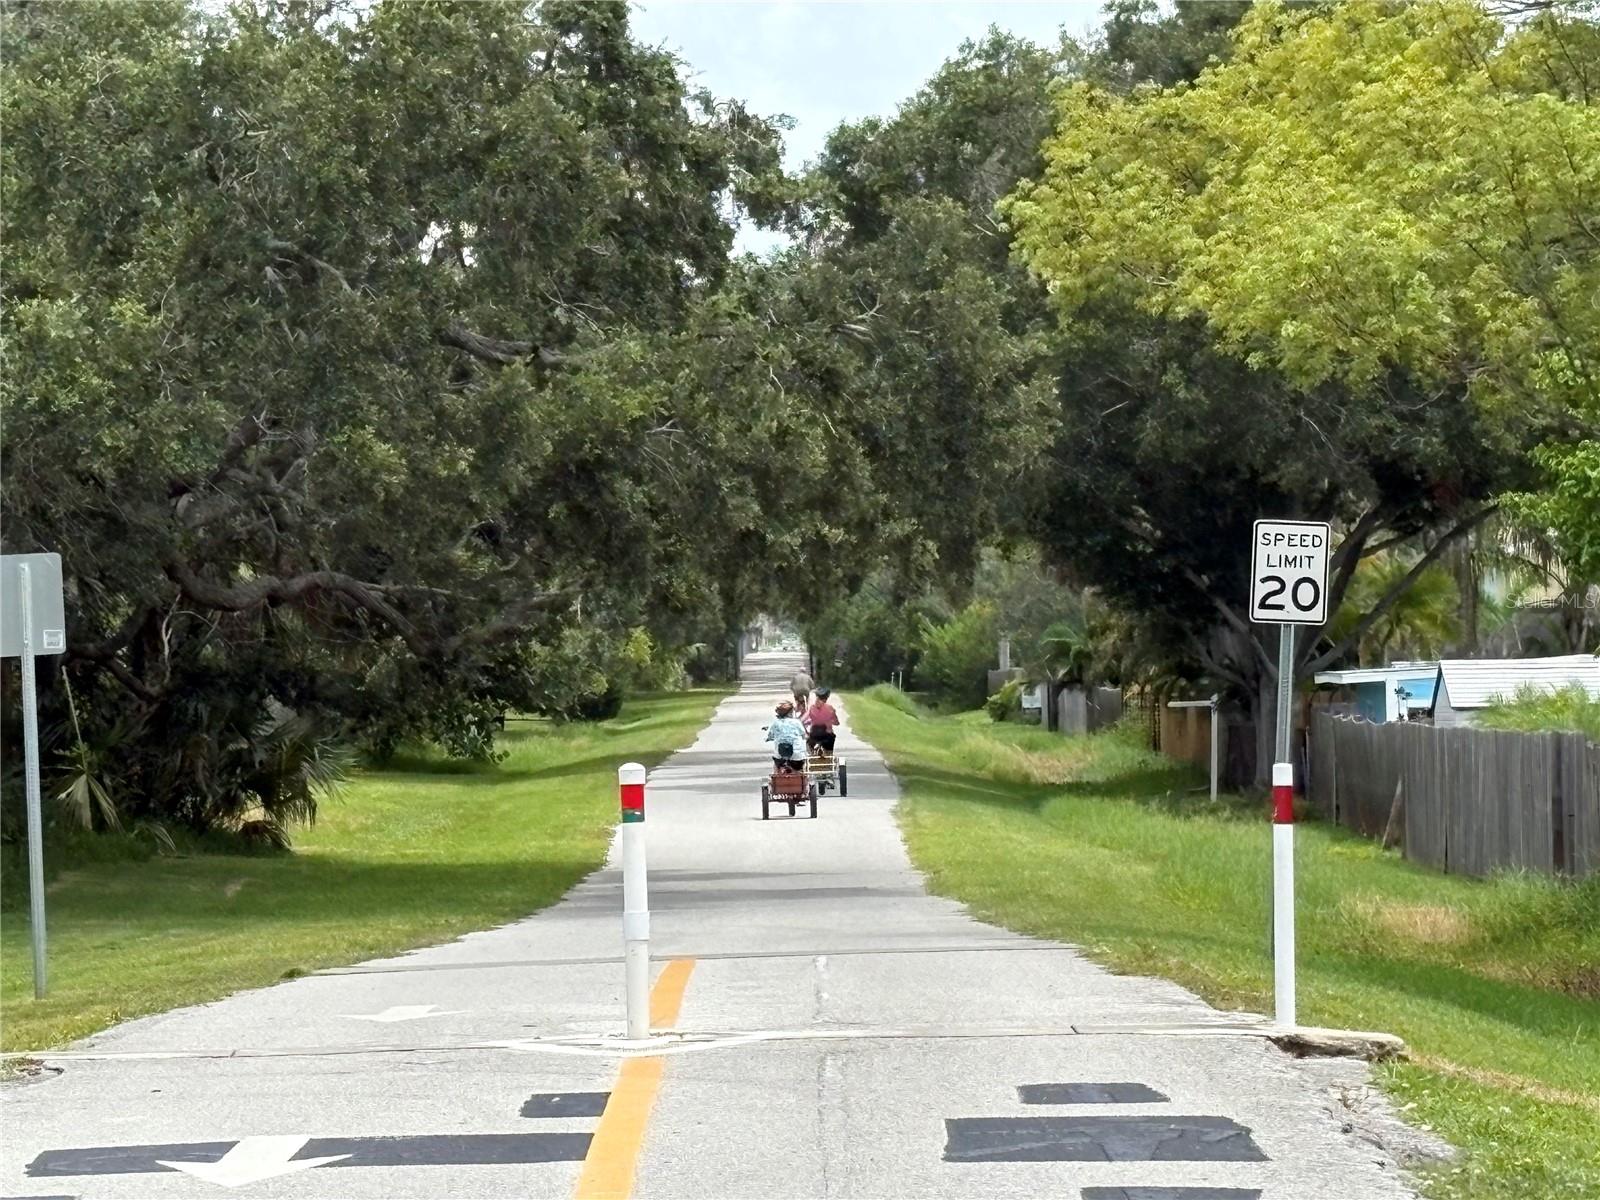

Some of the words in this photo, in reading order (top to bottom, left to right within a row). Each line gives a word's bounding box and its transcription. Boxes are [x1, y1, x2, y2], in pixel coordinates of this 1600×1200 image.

[1260, 532, 1323, 548] SPEED
[1266, 553, 1315, 569] LIMIT
[1257, 575, 1320, 612] 20
